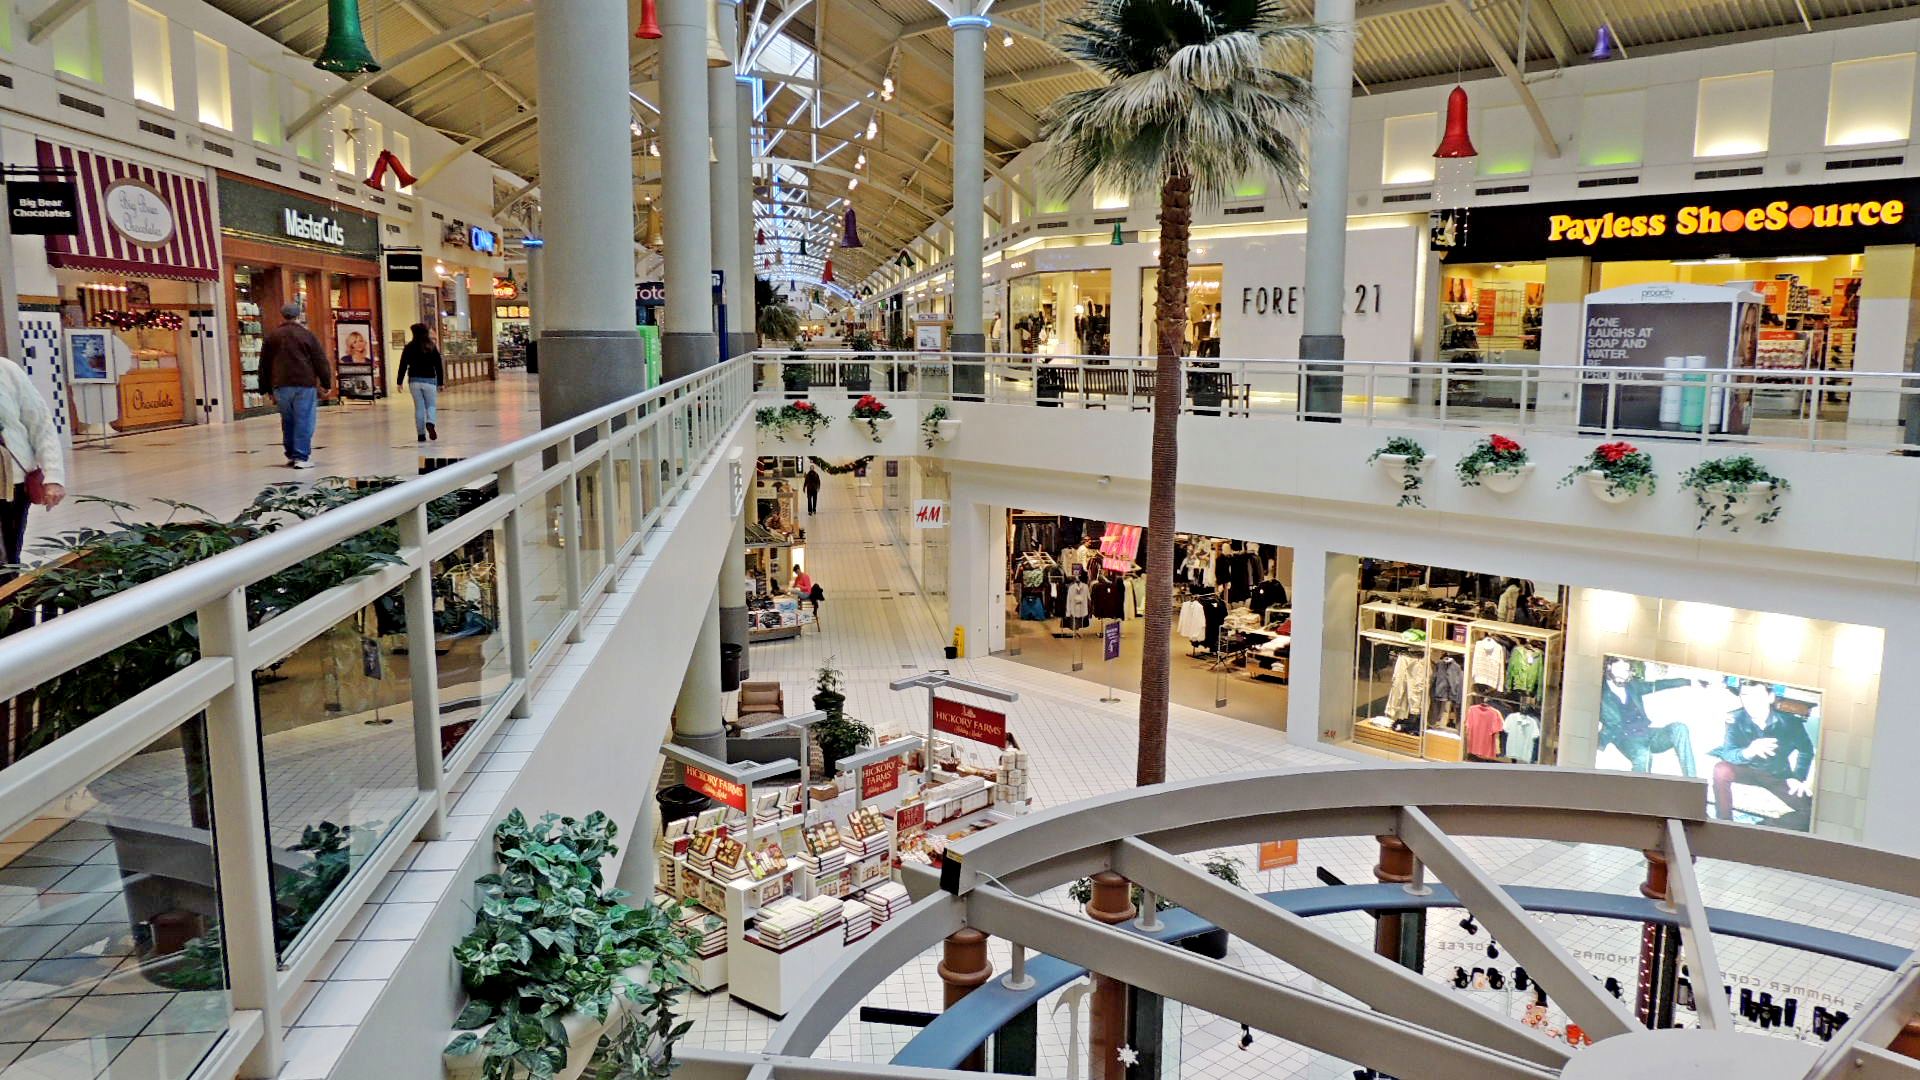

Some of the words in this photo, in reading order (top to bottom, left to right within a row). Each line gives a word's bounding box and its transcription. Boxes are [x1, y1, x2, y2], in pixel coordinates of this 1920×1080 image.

[19, 198, 36, 208] Big
[38, 198, 62, 207] Bear
[13, 208, 72, 218] Chocolates
[285, 207, 345, 246] MasterCuts
[1547, 212, 1666, 246] Payless
[1676, 200, 1904, 236] ShoeSource
[1354, 284, 1381, 314] 21
[1588, 317, 1620, 328] ACNE
[1588, 327, 1636, 338] LAUGHS
[1638, 327, 1654, 338] AT
[1587, 338, 1619, 349] SOAP
[1622, 338, 1647, 349] AND
[1586, 349, 1630, 359] WATER.
[1585, 371, 1644, 380] PROCTIV.
[132, 388, 174, 410] Chocolate
[916, 505, 941, 523] H&M
[935, 711, 973, 729] HICKORY
[973, 720, 1002, 736] FARMS
[862, 760, 897, 778] HICKORY
[686, 765, 718, 788] HICKORY
[718, 778, 744, 797] FARMS
[866, 771, 892, 786] FARMS
